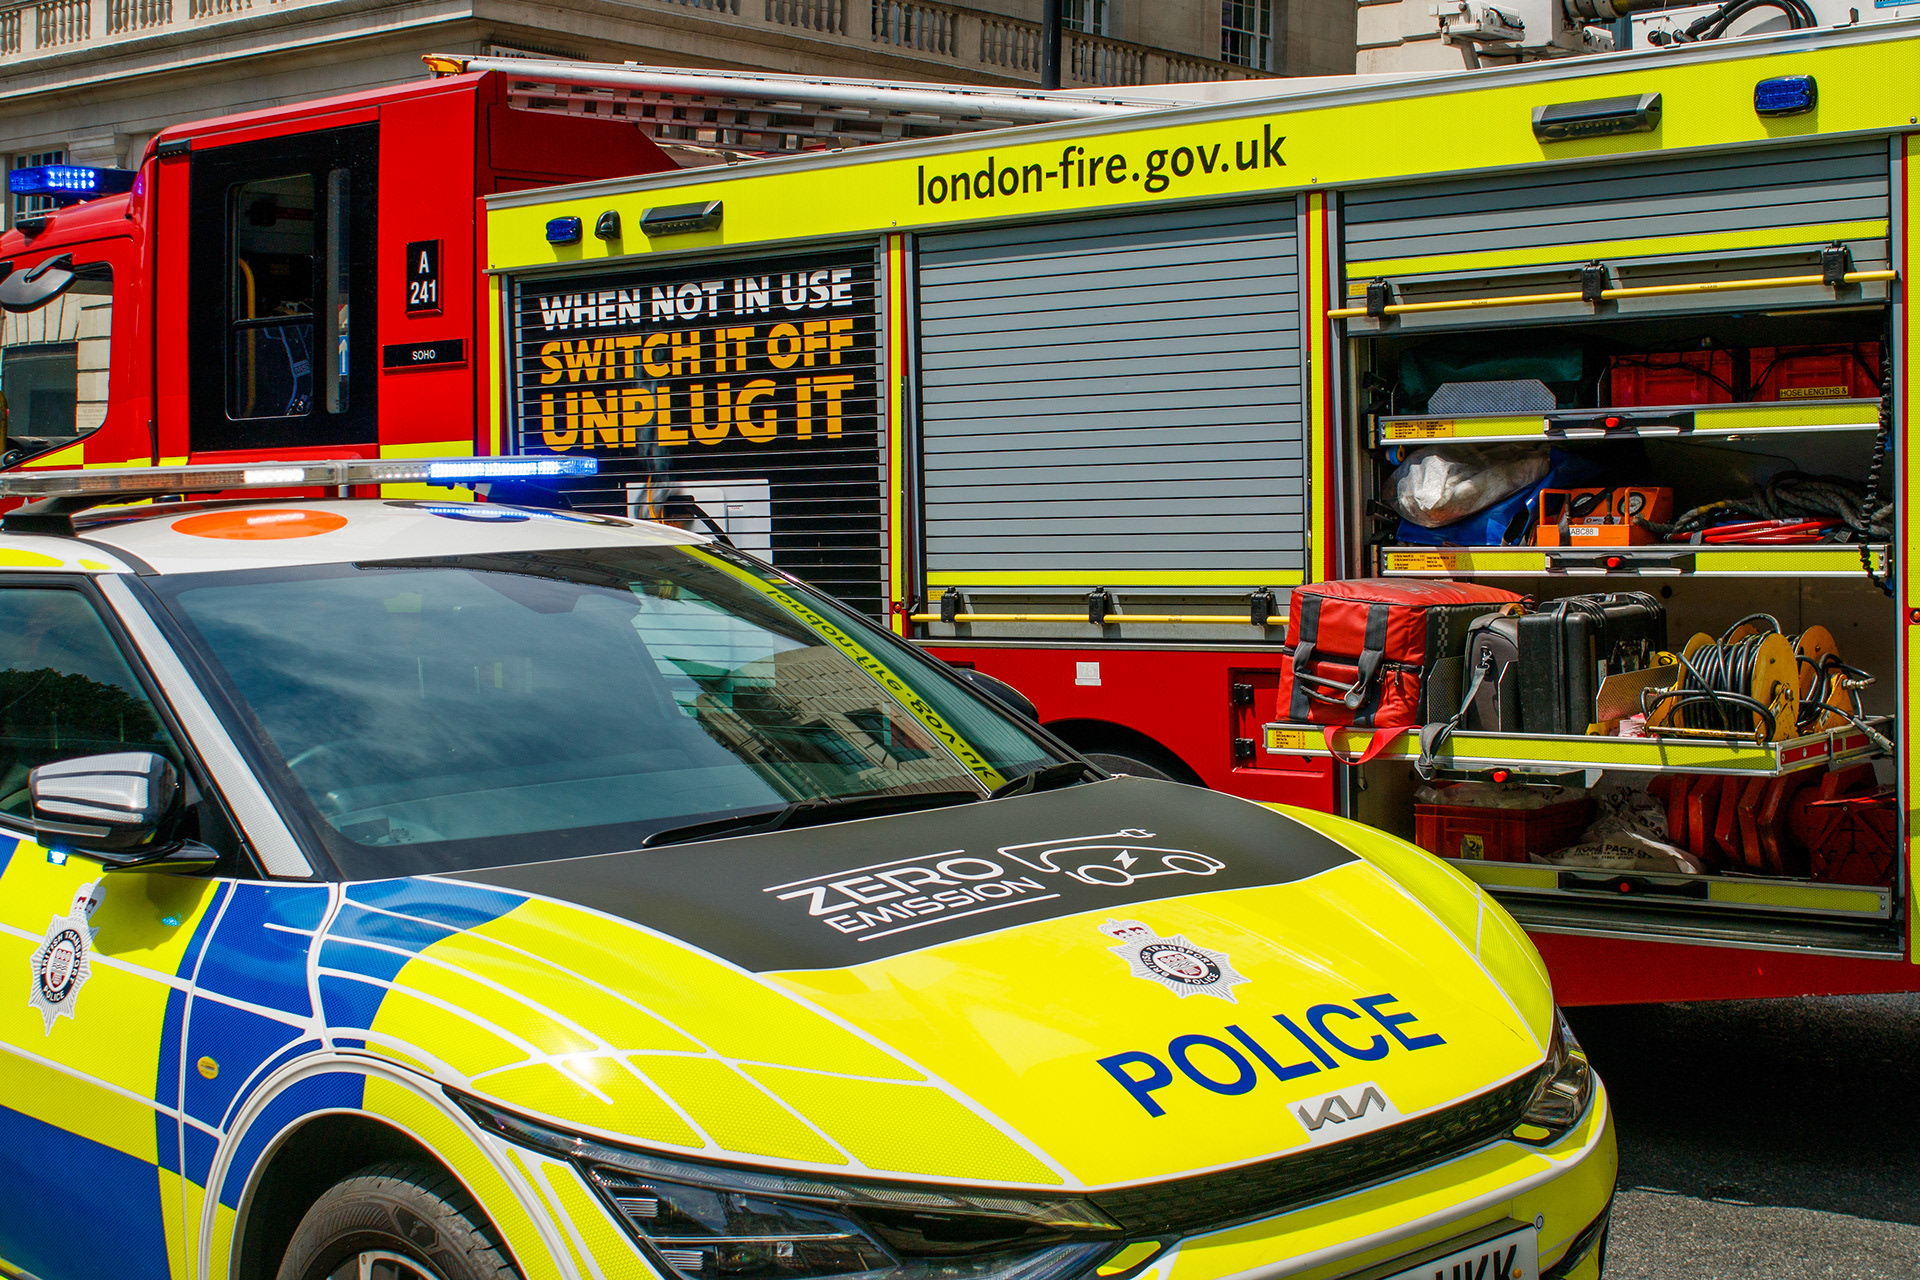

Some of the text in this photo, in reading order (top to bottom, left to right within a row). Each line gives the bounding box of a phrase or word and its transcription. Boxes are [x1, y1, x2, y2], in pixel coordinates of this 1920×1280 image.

[917, 123, 1288, 206] london-fire.gov.uk
[418, 250, 430, 274] A
[410, 279, 437, 304] 241
[539, 268, 854, 331] WHEN NOT IN USE
[412, 349, 436, 360] SOHO
[540, 318, 854, 385] SWITCH IT OFF
[541, 373, 855, 452] UNPLUG IT
[1780, 386, 1847, 397] HOSE LENGTHS &
[1570, 528, 1594, 536] ABC88
[1605, 844, 1635, 854] PACK
[776, 857, 1005, 916] ZERO
[822, 876, 1047, 934] EMISSION
[41, 930, 83, 1002] BRITISH TRANSPORT POLICE
[1141, 944, 1219, 985] BRITISH TRANSPORT POLICE
[1095, 992, 1448, 1119] POLICE
[1297, 1086, 1387, 1131] KIA
